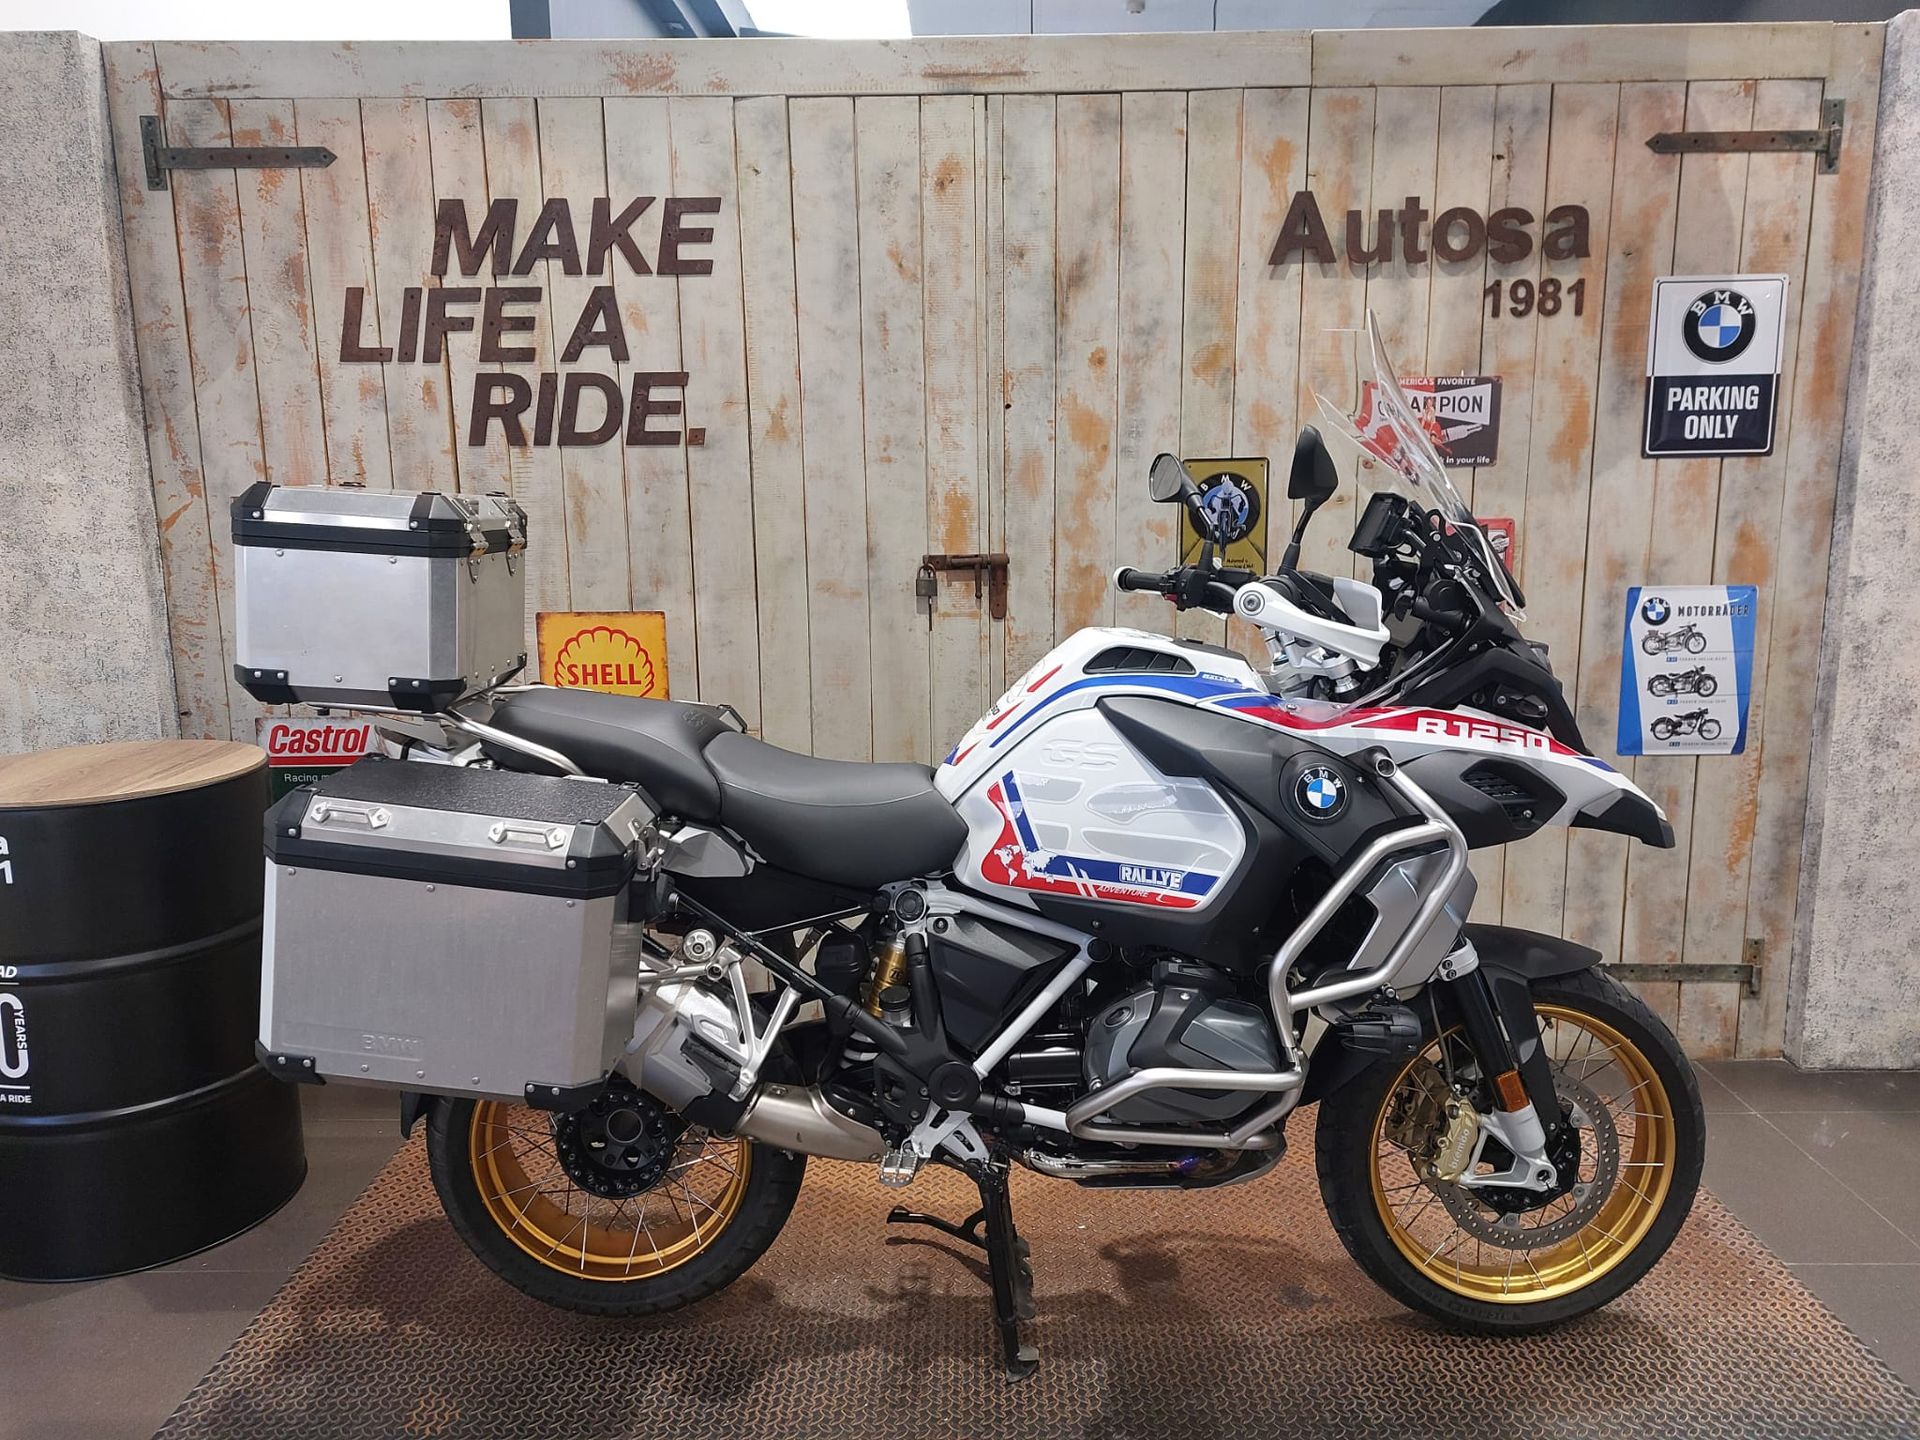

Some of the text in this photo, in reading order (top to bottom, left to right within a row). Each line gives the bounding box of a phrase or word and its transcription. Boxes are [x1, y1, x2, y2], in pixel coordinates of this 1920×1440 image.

[430, 196, 722, 276] MAKE
[1268, 190, 1591, 266] Autosa
[1483, 277, 1587, 319] 1981
[1690, 290, 1754, 317] BMW
[339, 285, 631, 364] LIFE A
[1398, 376, 1477, 386] MERICA'S FAVORITE
[468, 371, 706, 447] RIDE.
[1666, 385, 1760, 412] PARKING
[1683, 414, 1739, 440] ONLY
[1446, 456, 1456, 464] in
[1456, 457, 1475, 466] your
[1476, 455, 1490, 464] life
[1199, 473, 1252, 492] BMW
[566, 663, 643, 686] SHELL
[268, 724, 371, 754] Castrol
[1416, 716, 1552, 752] R1250
[284, 772, 319, 783] Racing
[1303, 769, 1343, 789] BMW
[1121, 866, 1181, 888] RALLYE
[1097, 885, 1150, 898] ADVENTURE
[13, 1008, 28, 1051] YEARS
[8, 1094, 32, 1104] RIDE
